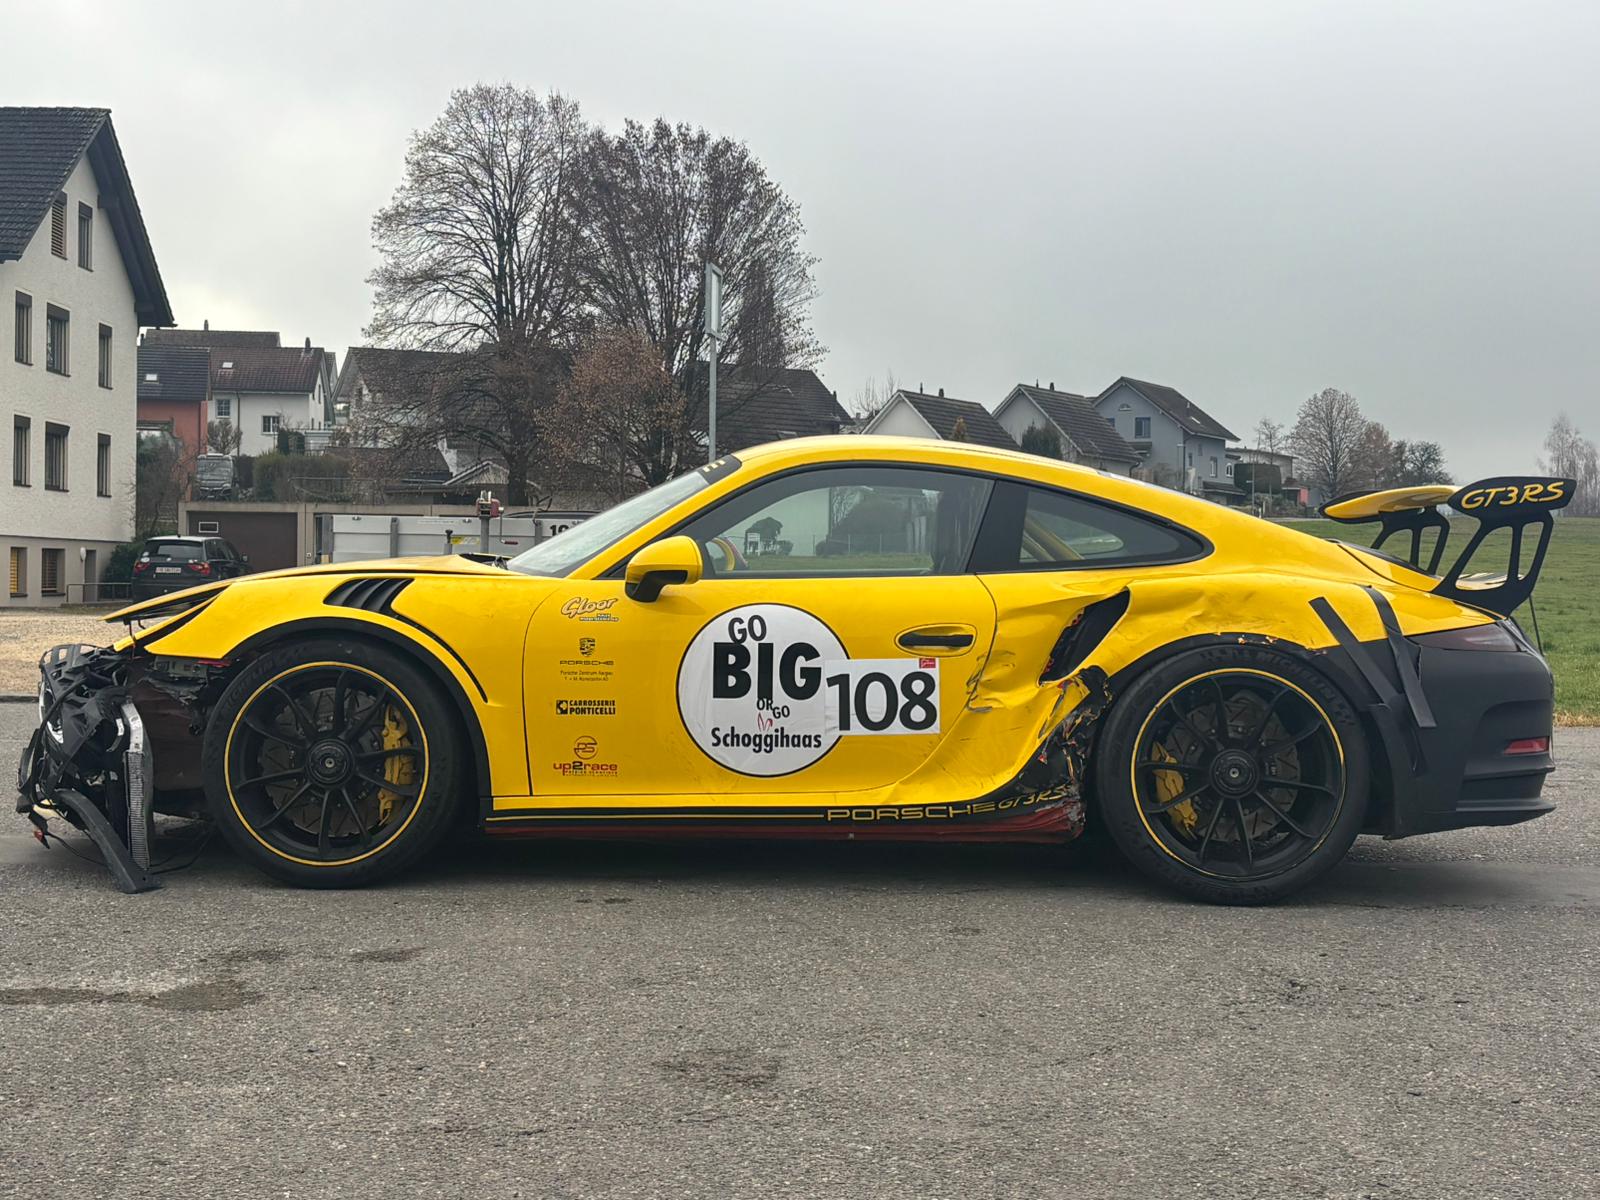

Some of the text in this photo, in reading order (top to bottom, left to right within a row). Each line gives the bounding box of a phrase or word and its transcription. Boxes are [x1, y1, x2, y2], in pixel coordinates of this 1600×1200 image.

[561, 597, 618, 619] Gloor
[728, 614, 767, 643] GO
[712, 642, 822, 700] BIG
[569, 707, 616, 715] PONTICELLI
[756, 700, 790, 719] OR GO
[826, 671, 937, 731] 108
[711, 726, 822, 753] Schoggihaas
[553, 761, 618, 776] up2race
[827, 802, 996, 821] PORSCHE
